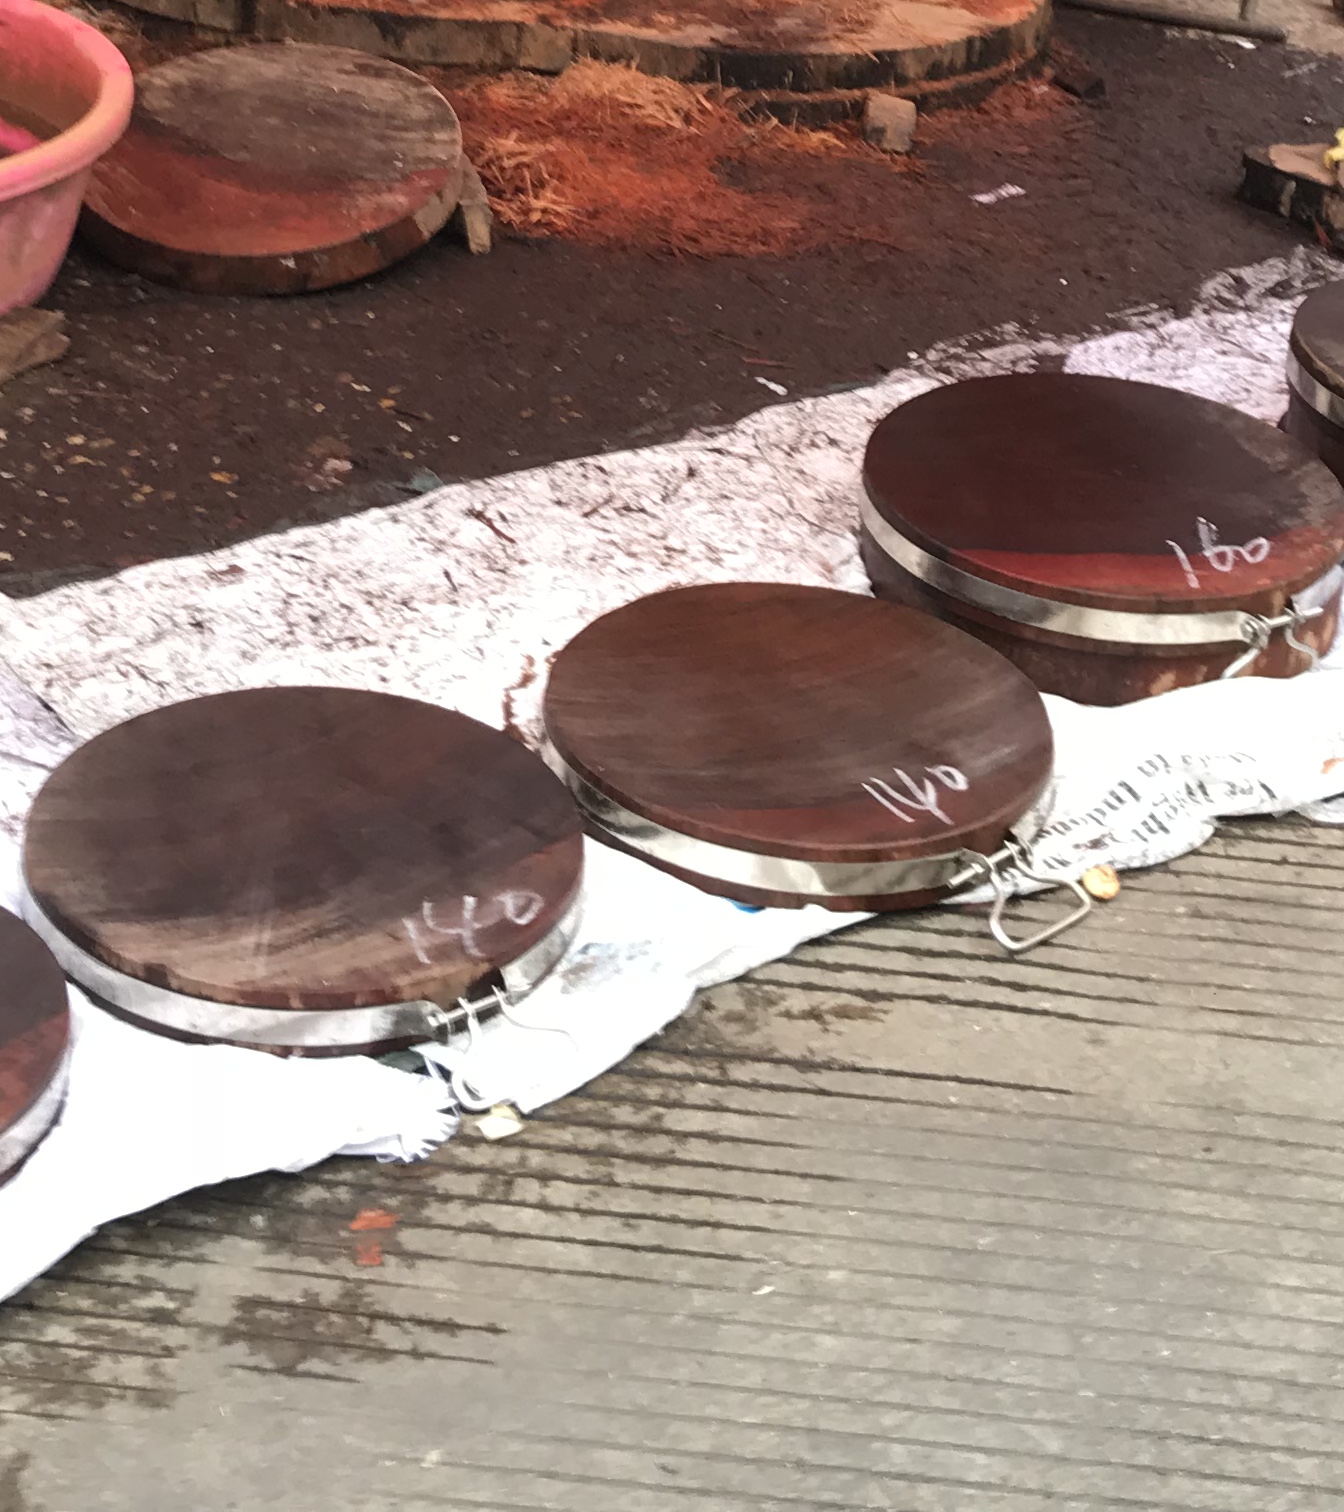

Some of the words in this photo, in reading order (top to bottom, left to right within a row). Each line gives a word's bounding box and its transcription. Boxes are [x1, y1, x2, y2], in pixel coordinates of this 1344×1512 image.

[1165, 515, 1272, 590] 160
[860, 764, 969, 826] 140
[401, 889, 546, 965] 140
